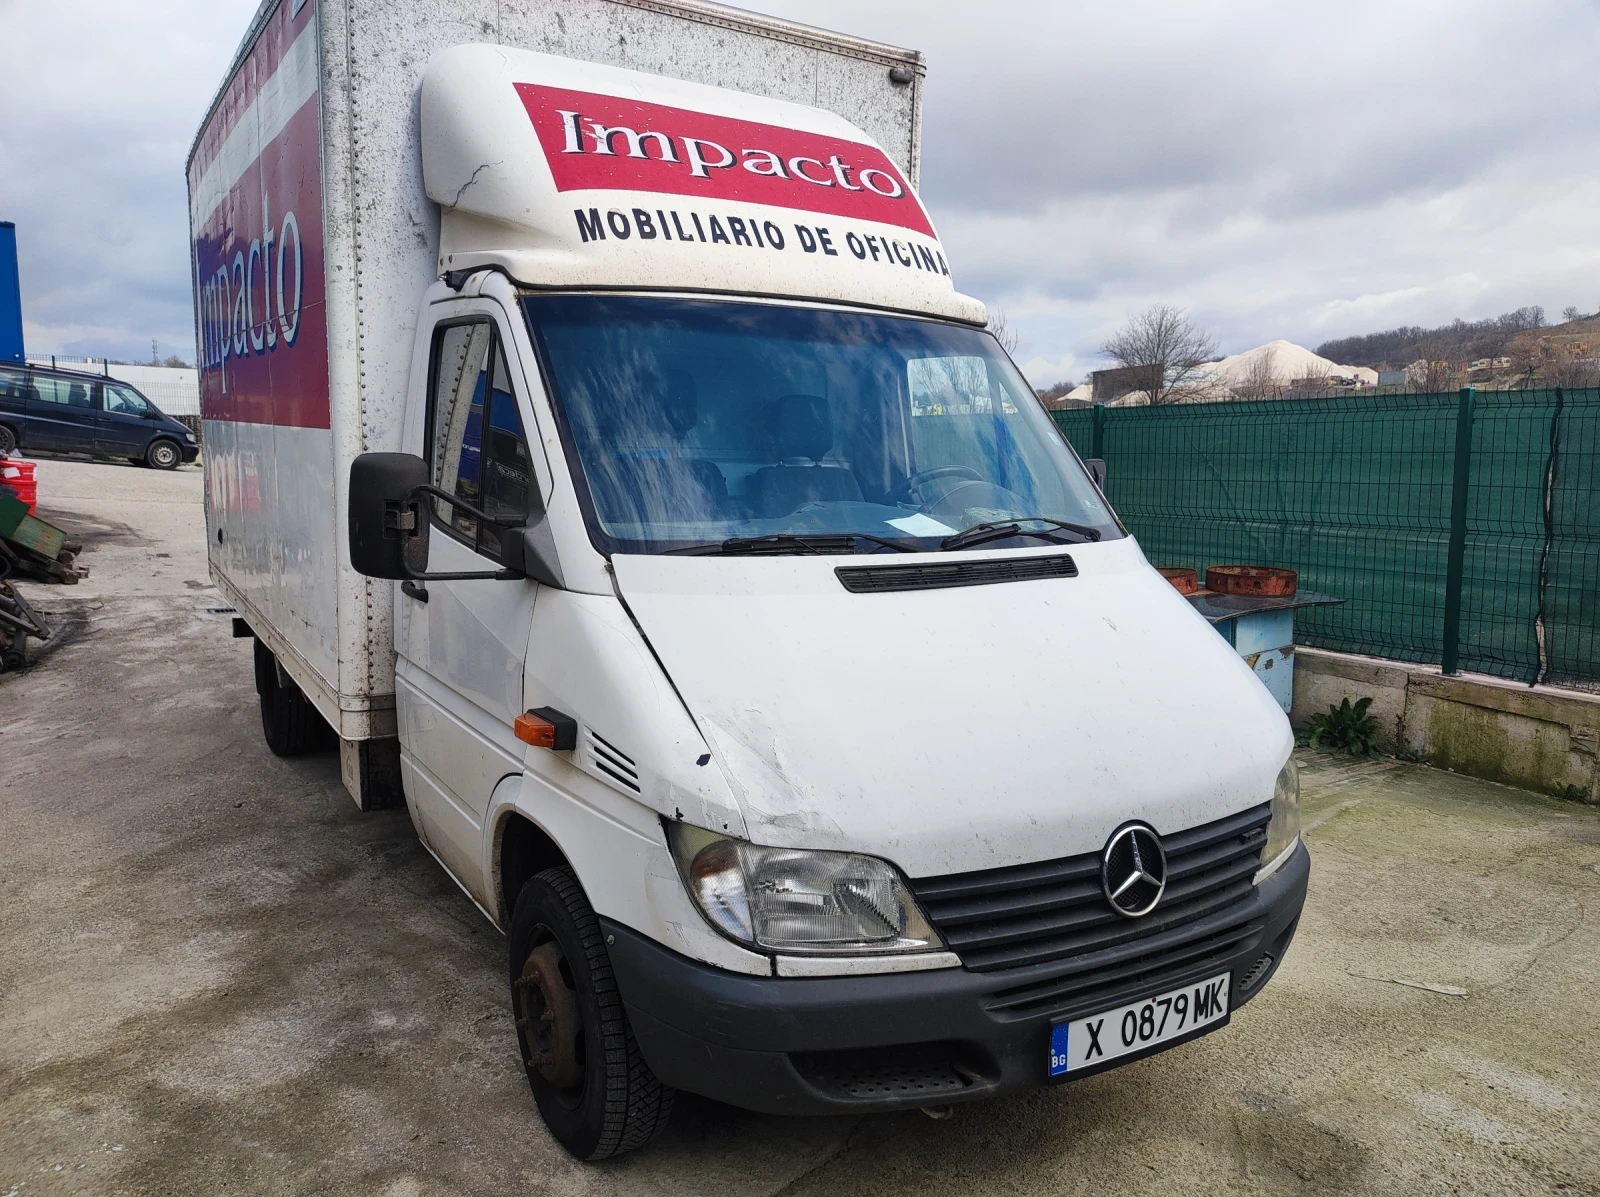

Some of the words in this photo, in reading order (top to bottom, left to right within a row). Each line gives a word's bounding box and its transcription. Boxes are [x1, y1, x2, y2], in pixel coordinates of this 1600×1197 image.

[555, 110, 905, 199] Impacto
[574, 207, 785, 250] MOBILIARIO
[794, 224, 838, 257] DE
[846, 231, 951, 279] OFICINA
[195, 190, 303, 394] Impacto
[1051, 1052, 1066, 1068] BG
[1085, 1018, 1104, 1060] X
[1121, 993, 1188, 1047] 0879
[1193, 978, 1225, 1024] MK
